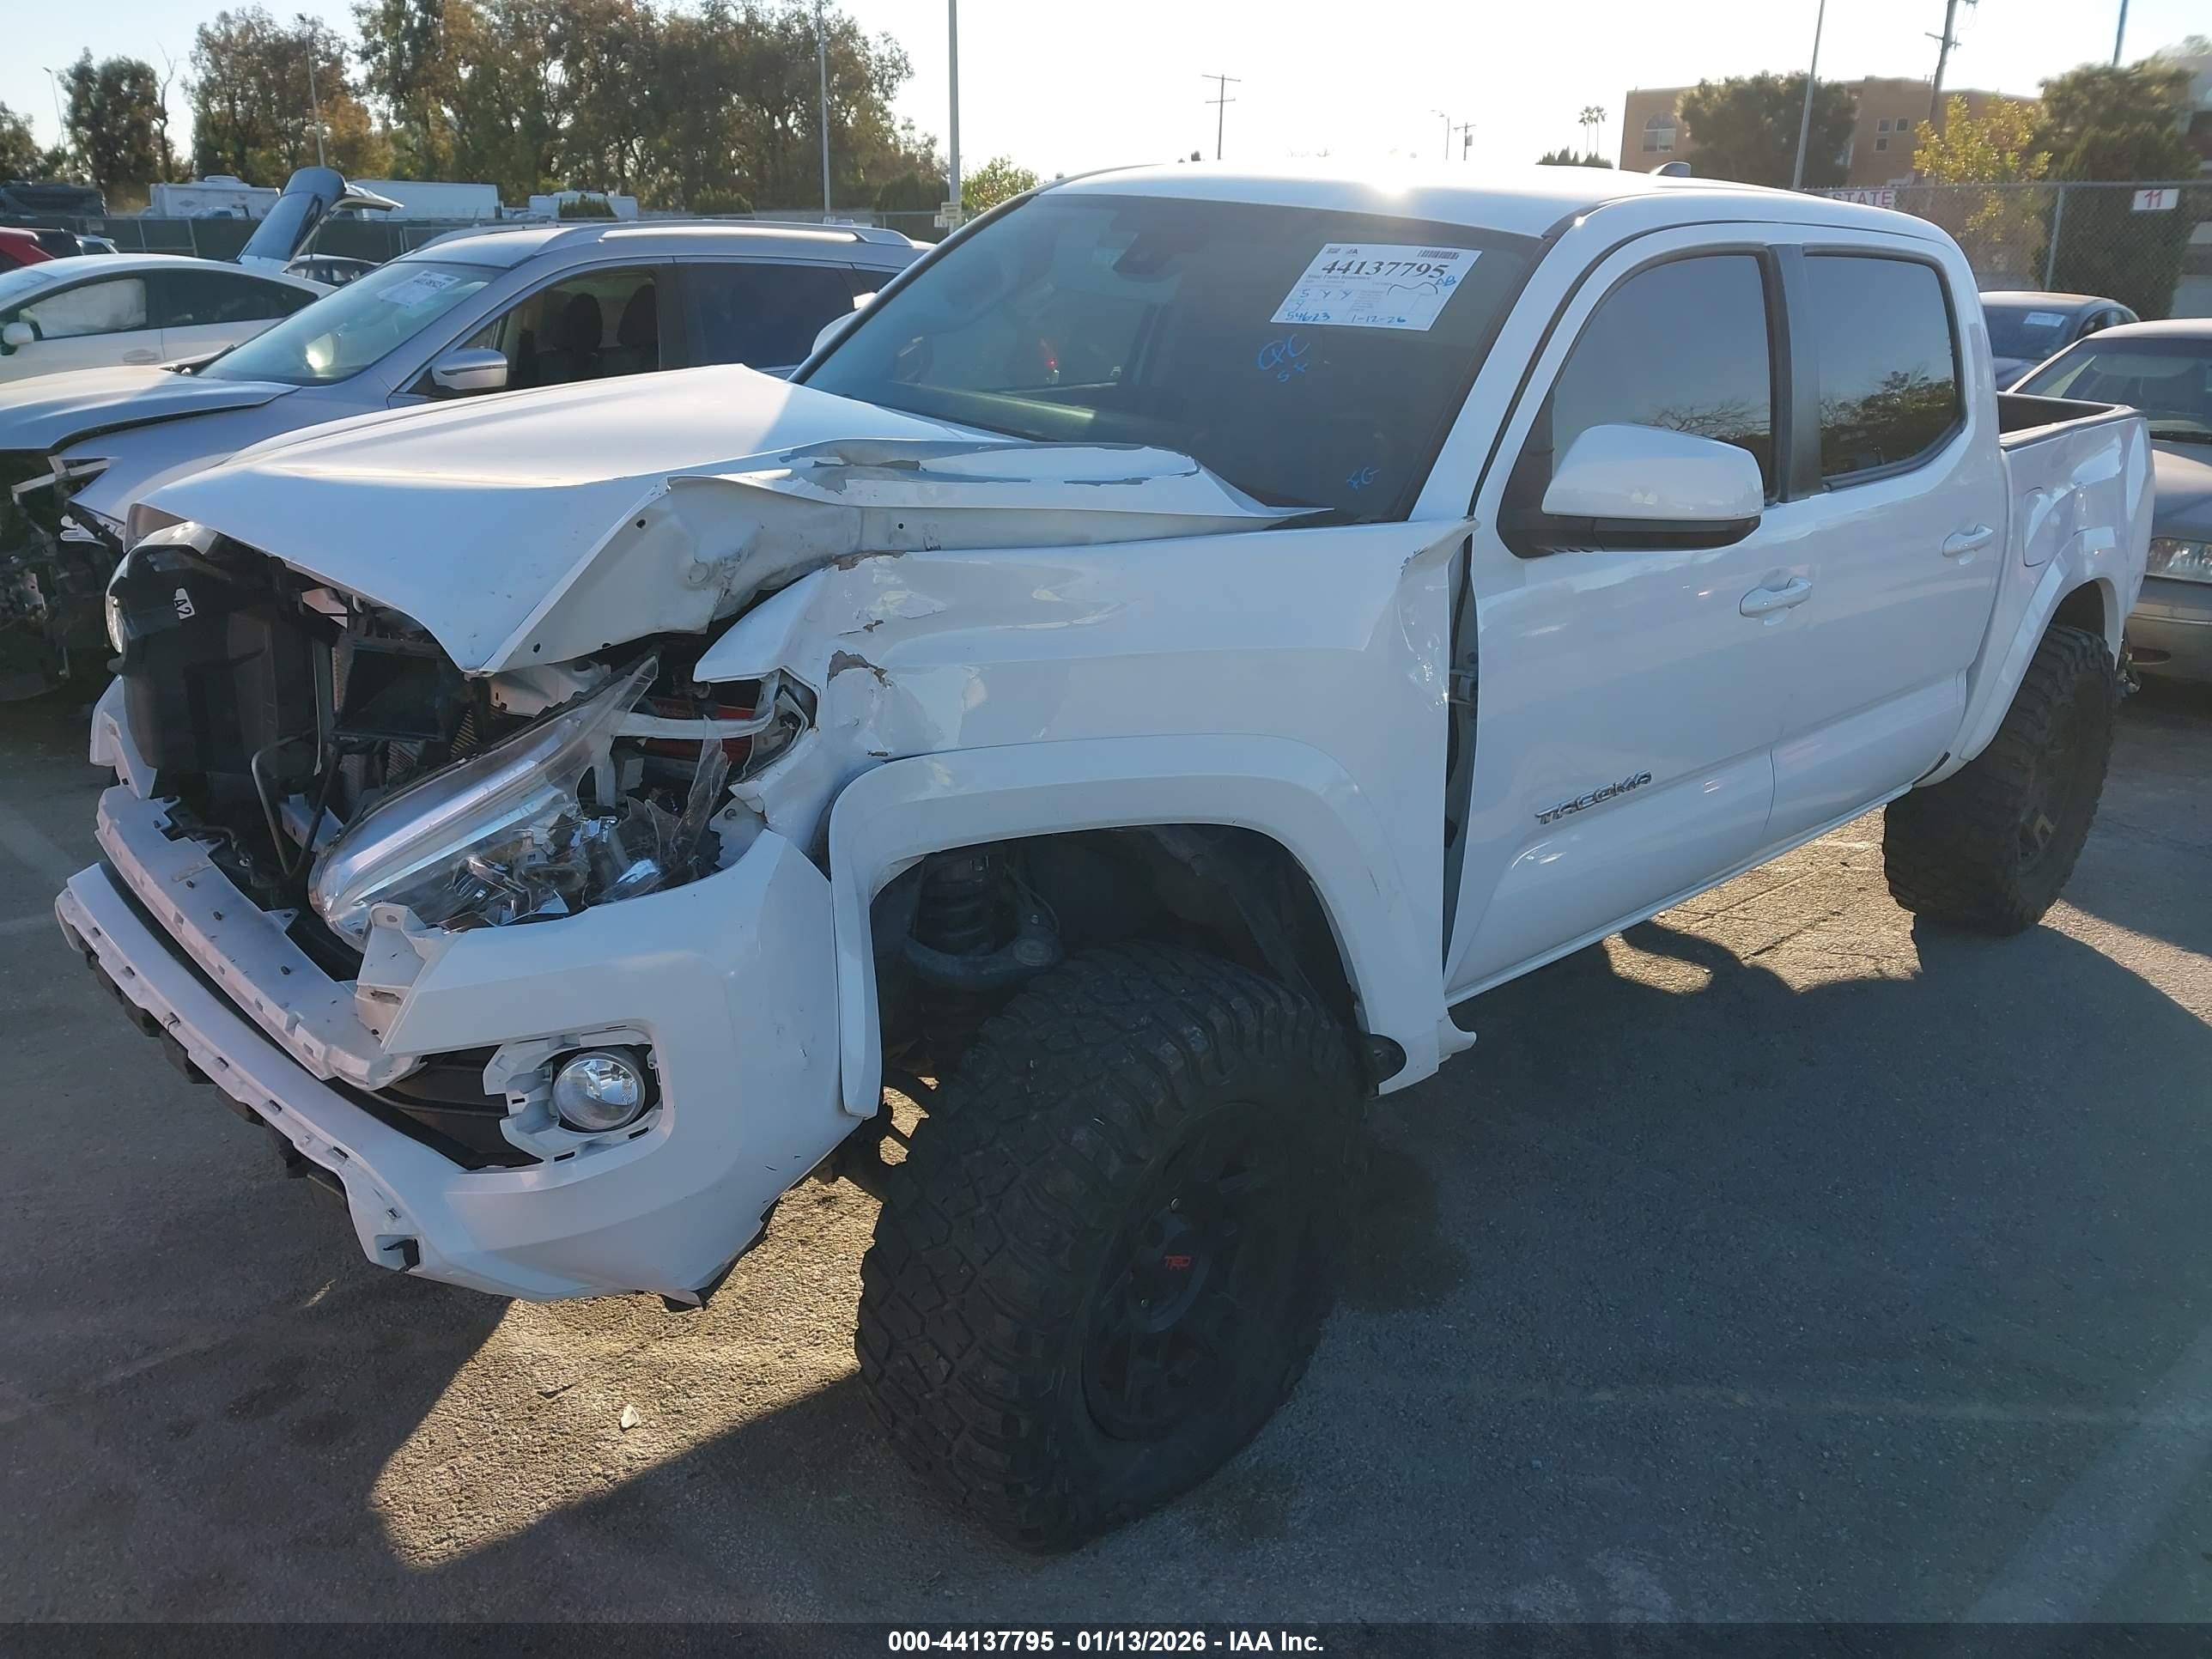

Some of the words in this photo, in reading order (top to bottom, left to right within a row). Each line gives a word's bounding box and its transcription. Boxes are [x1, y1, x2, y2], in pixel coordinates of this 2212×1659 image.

[2143, 189, 2163, 208] 11
[1322, 259, 1449, 279] 44137795
[1352, 313, 1407, 323] 1-12-26
[173, 599, 192, 615] A2
[1534, 769, 1653, 825] TACOMA
[1164, 1255, 1192, 1271] TRD
